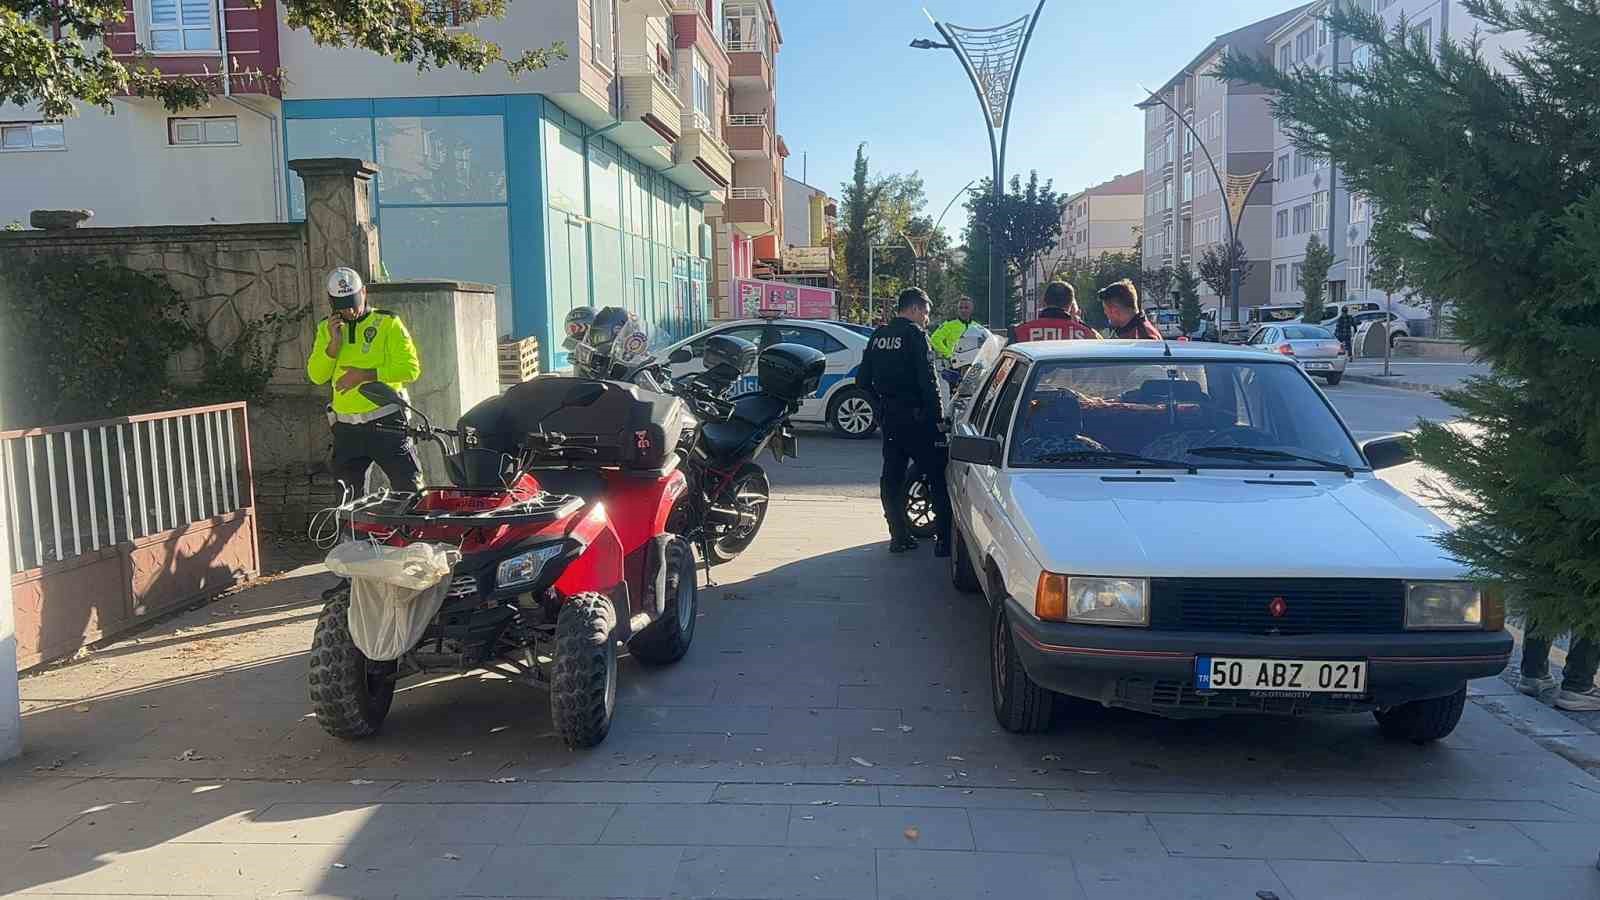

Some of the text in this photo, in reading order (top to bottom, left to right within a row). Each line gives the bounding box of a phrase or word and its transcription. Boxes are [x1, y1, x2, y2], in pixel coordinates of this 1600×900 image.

[1197, 674, 1209, 683] TR
[1213, 662, 1361, 689] 50 ABZ 021
